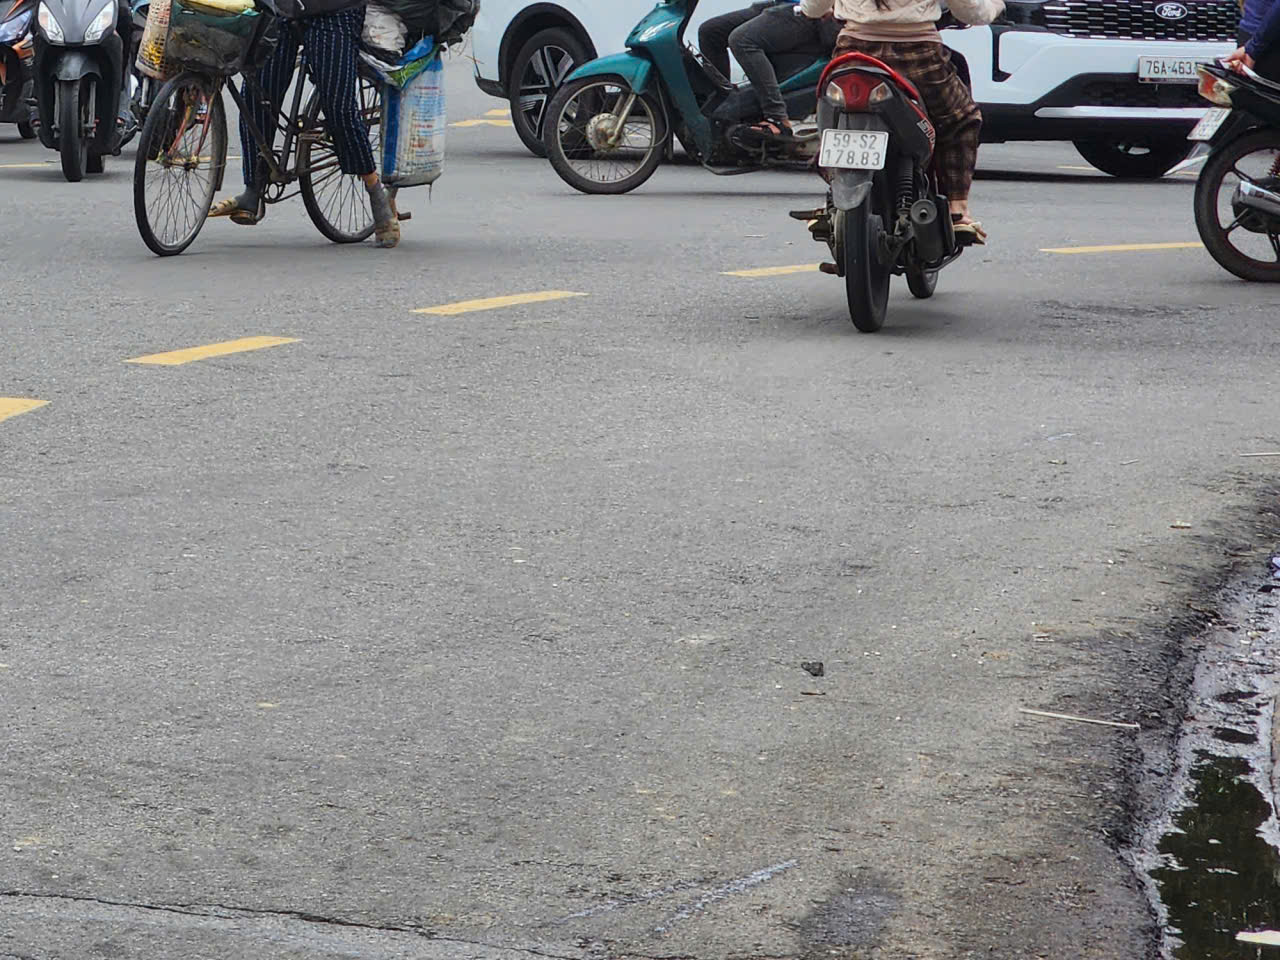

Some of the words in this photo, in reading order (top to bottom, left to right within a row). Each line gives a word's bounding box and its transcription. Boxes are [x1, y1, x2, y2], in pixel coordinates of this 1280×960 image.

[1161, 4, 1182, 17] Ford
[1145, 60, 1197, 76] 76A-463.
[832, 133, 877, 149] 59-S2
[825, 149, 881, 166] 178.83
